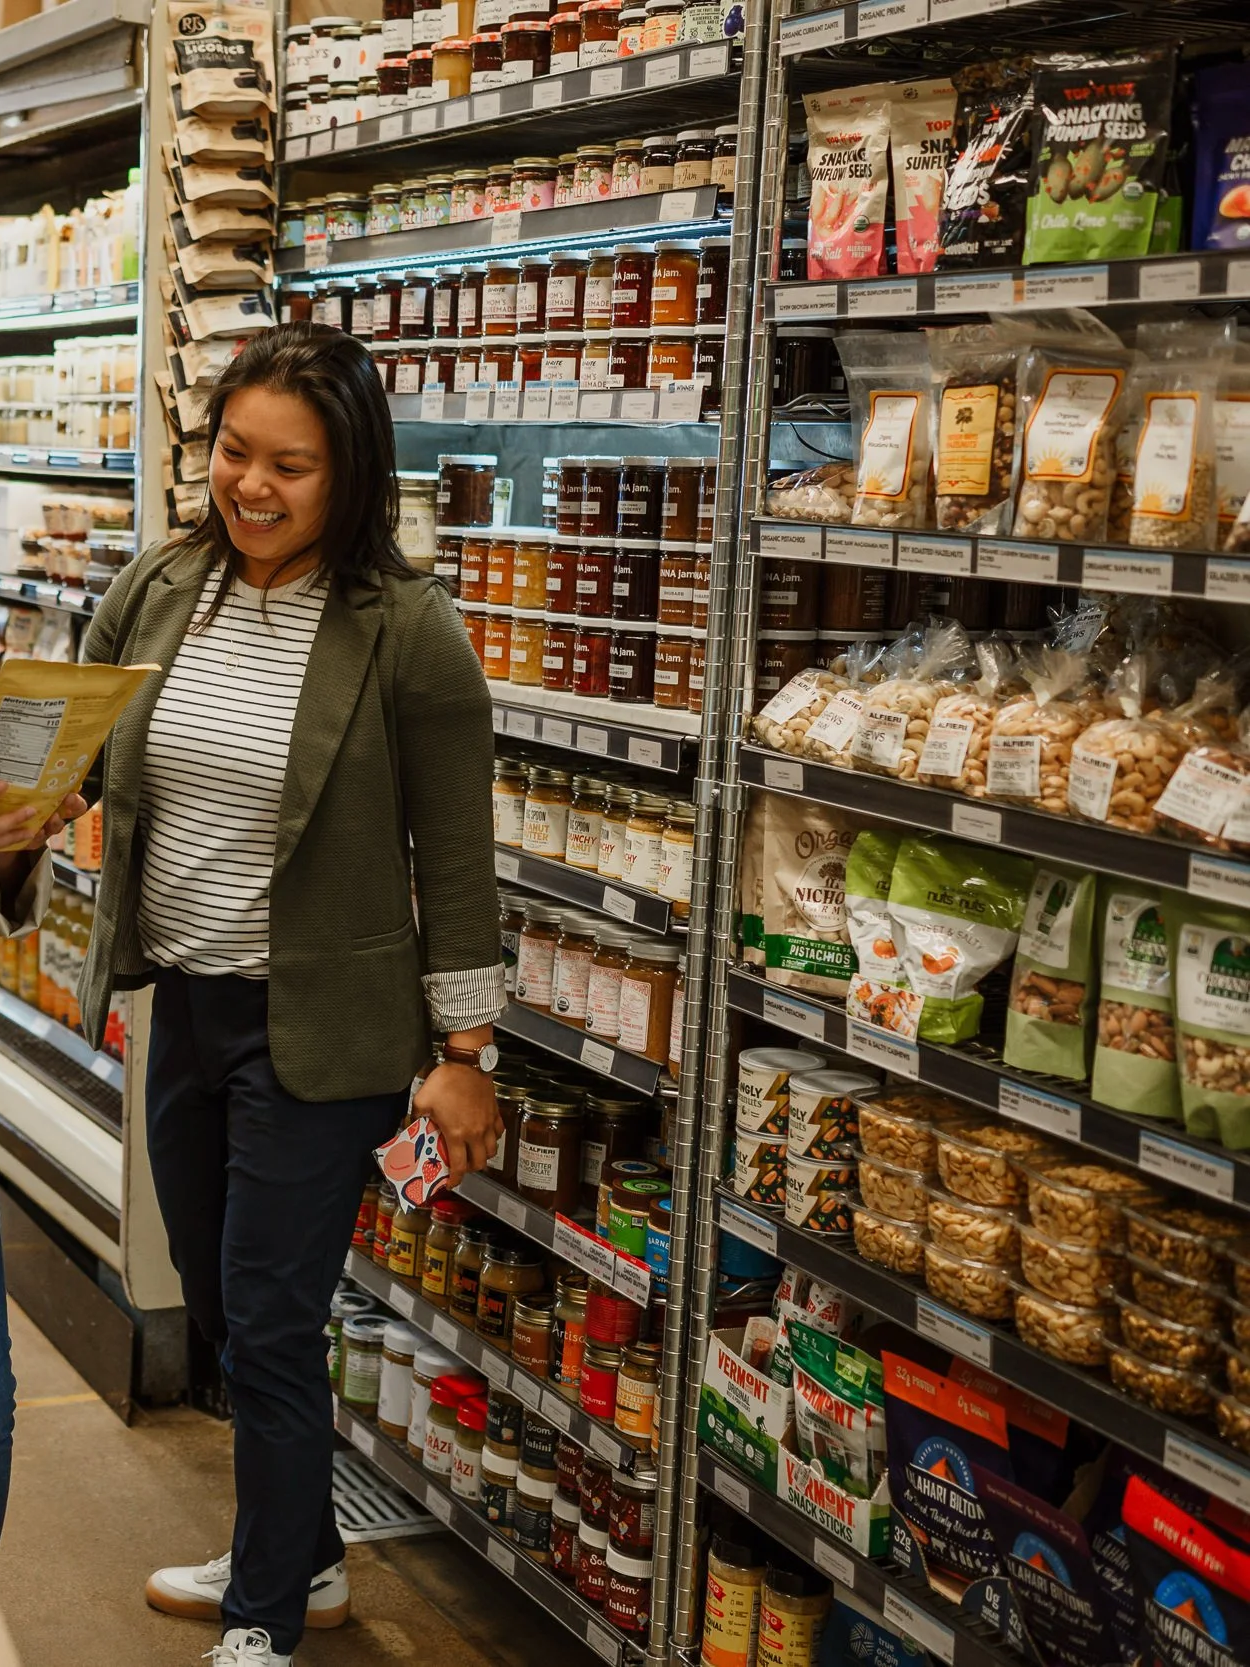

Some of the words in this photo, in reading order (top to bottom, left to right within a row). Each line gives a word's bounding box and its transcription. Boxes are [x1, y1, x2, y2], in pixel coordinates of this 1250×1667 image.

[859, 9, 885, 22] ORGANIC
[886, 5, 906, 17] PRUNE
[781, 30, 802, 40] ORGANIC
[802, 25, 823, 36] CURRANT
[824, 21, 839, 31] ZANTE
[1055, 103, 1143, 125] SNACKING
[926, 120, 952, 132] TOP
[1103, 122, 1147, 139] SEEDS
[623, 271, 642, 281] jam.
[662, 268, 682, 278] jam.
[659, 355, 679, 364] jam.
[699, 354, 716, 363] jam.
[632, 483, 651, 493] jam.
[444, 549, 460, 558] jam.
[584, 563, 601, 573] jam.
[781, 573, 803, 583] jam.
[551, 639, 567, 649] jam.
[619, 646, 637, 658] jam.
[665, 653, 684, 663] jam.
[764, 658, 786, 668] jam.
[3, 697, 42, 707] Nutrition
[870, 712, 903, 723] ALFIERI
[810, 941, 826, 949] WITH
[764, 998, 784, 1012] ORGANIC
[852, 1033, 867, 1044] SWEET
[887, 1045, 911, 1061] CASHEWS
[528, 1147, 556, 1155] ALFIERI
[530, 1162, 552, 1170] BUTTER
[717, 1347, 770, 1404] VERMONT
[912, 1375, 936, 1396] PROTEIN
[525, 1438, 552, 1453] tahini
[786, 1458, 856, 1528] VRMONT
[788, 1486, 818, 1522] SNACK
[818, 1509, 853, 1543] STICKS
[893, 1525, 912, 1552] 32g
[610, 1578, 640, 1595] Soom
[985, 1585, 1000, 1610] 0g
[608, 1599, 637, 1616] tahini
[886, 1594, 914, 1621] ORIGINAL
[878, 1635, 895, 1652] true
[877, 1647, 899, 1666] origin
